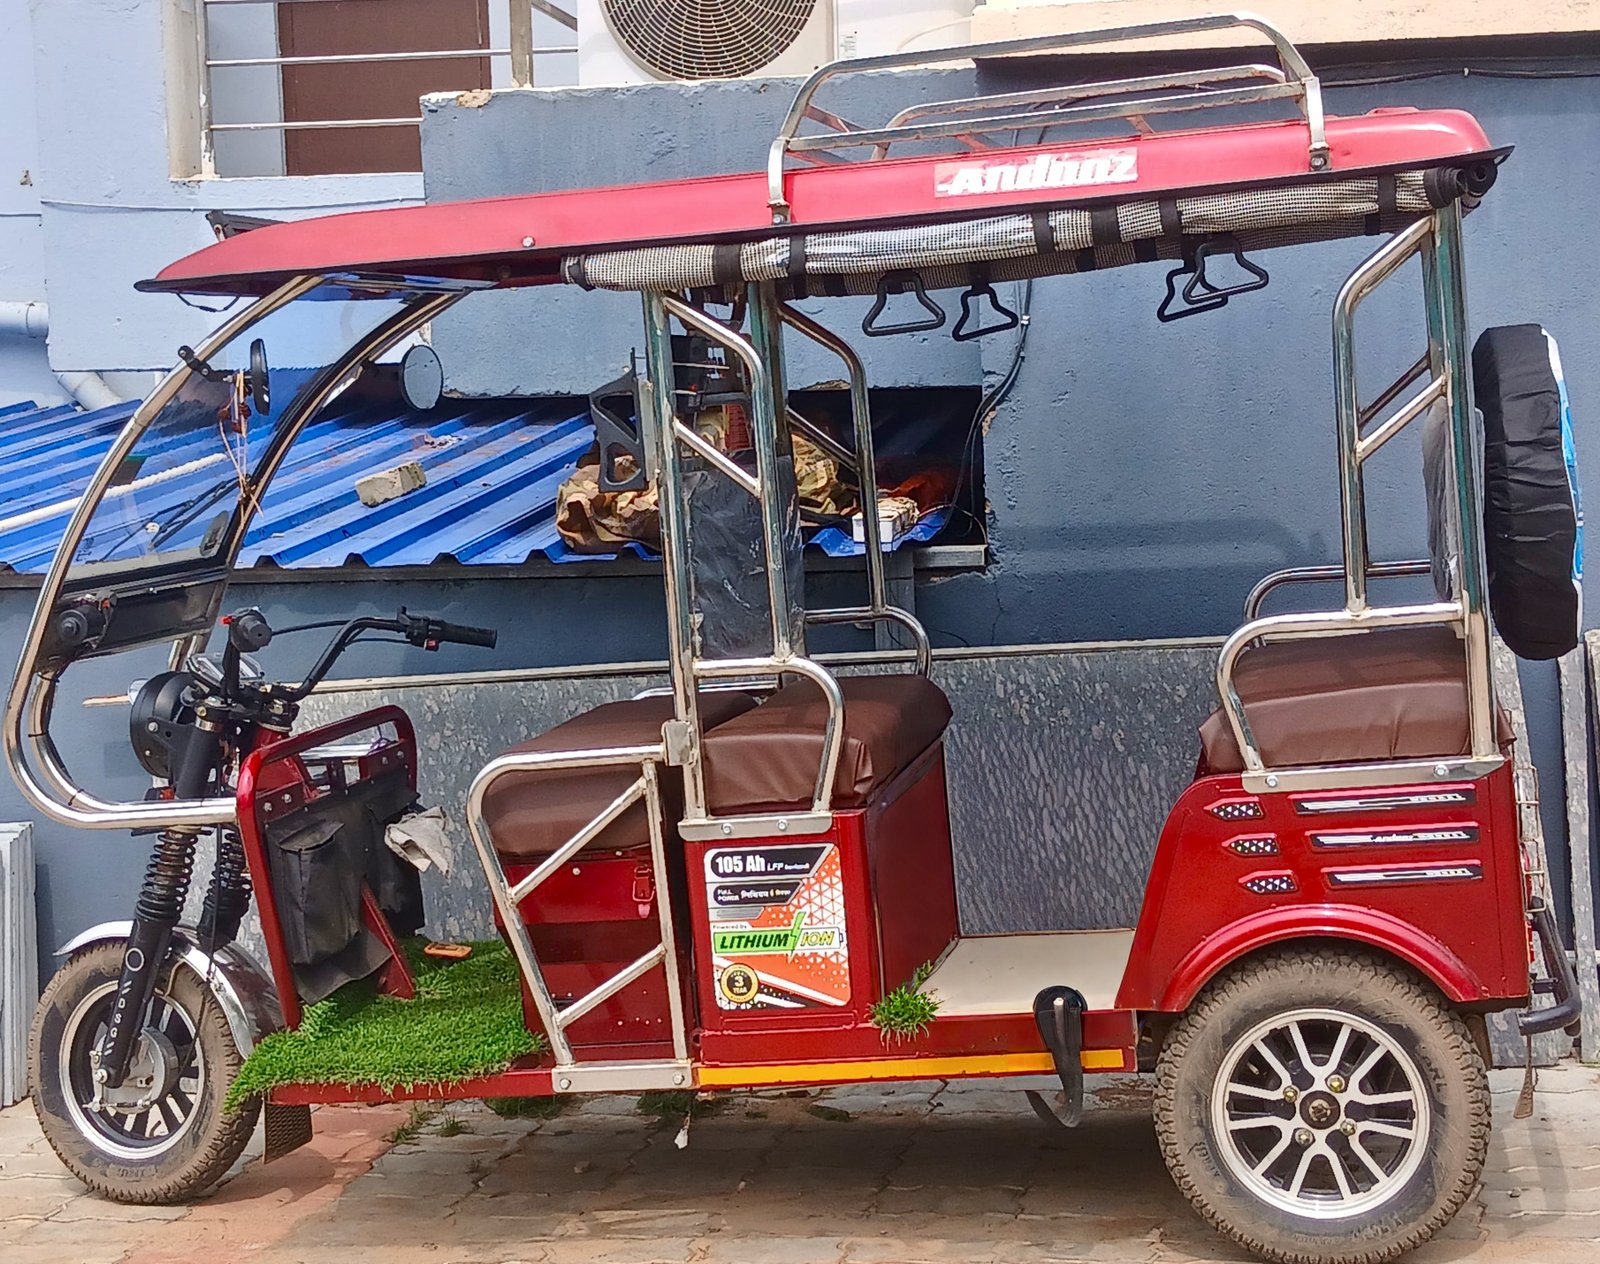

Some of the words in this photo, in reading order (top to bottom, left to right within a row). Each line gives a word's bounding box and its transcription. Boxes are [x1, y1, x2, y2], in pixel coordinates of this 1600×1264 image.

[715, 855, 743, 874] 105
[745, 854, 766, 872] Ah
[720, 933, 790, 950] LITHIUM
[800, 930, 835, 947] ION
[733, 975, 745, 987] 3
[110, 998, 126, 1038] DSG
